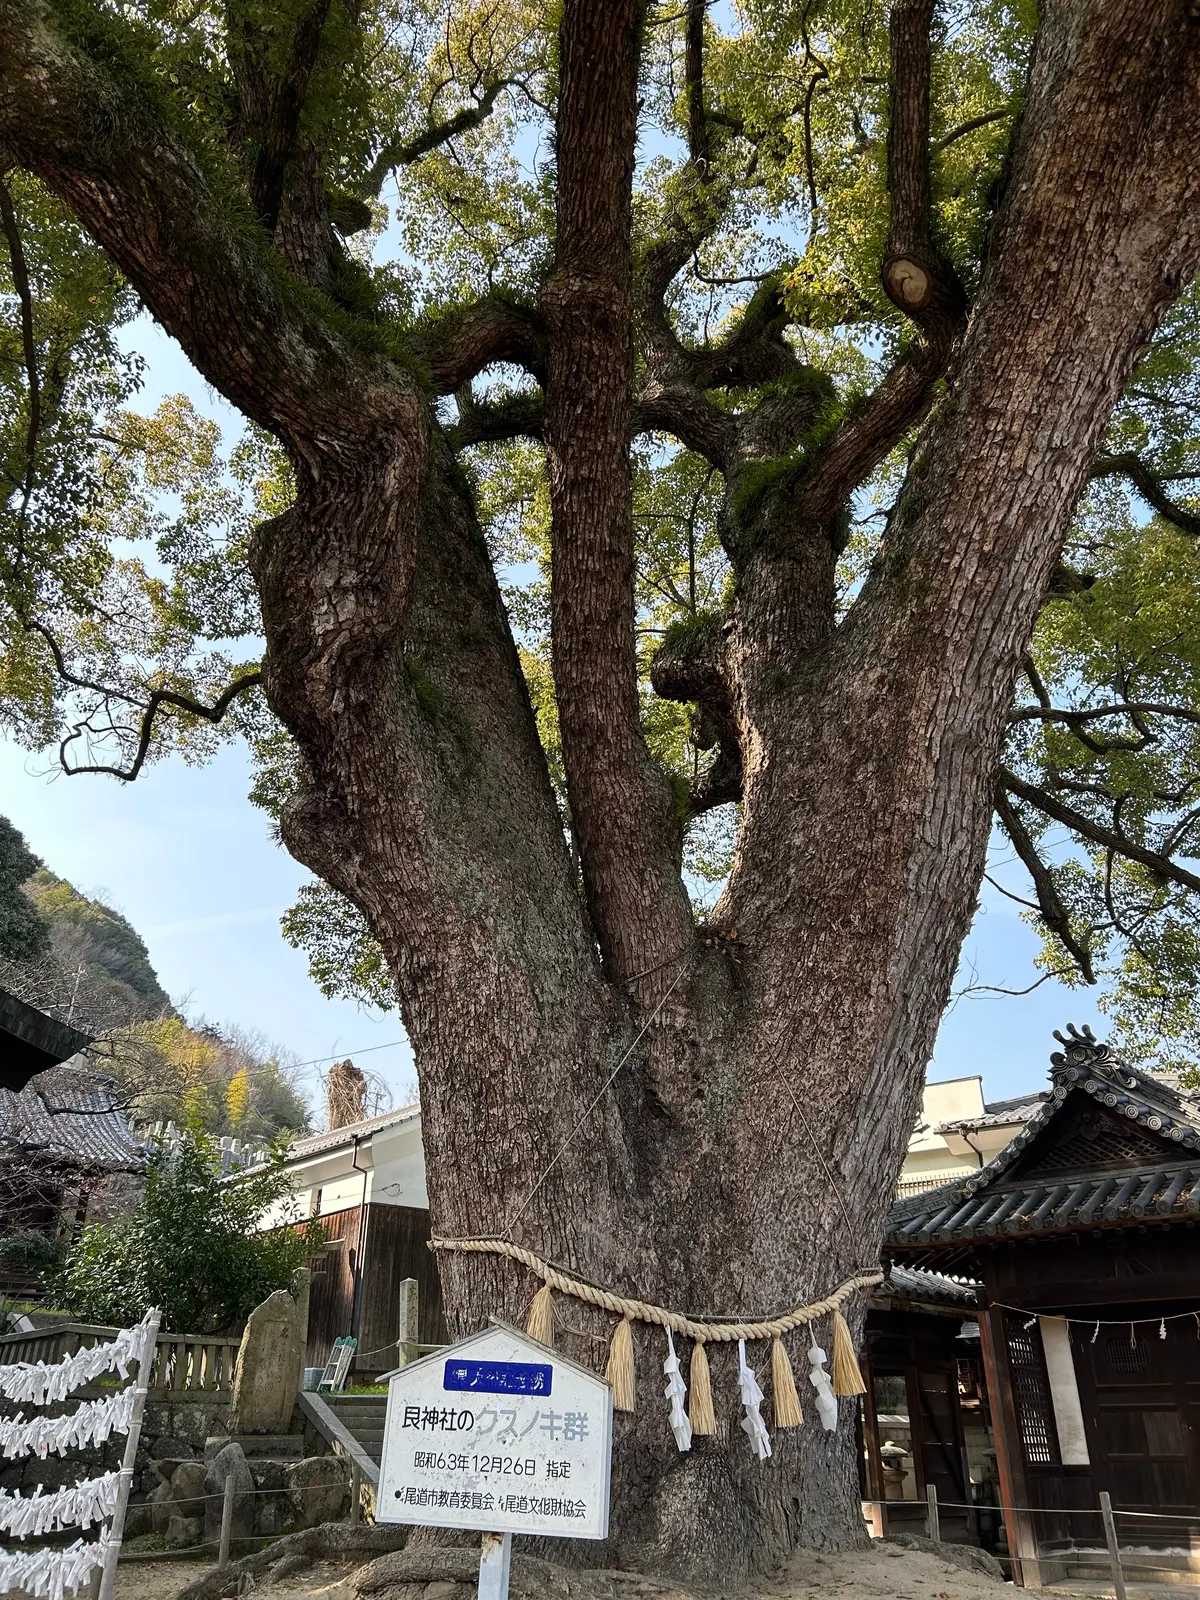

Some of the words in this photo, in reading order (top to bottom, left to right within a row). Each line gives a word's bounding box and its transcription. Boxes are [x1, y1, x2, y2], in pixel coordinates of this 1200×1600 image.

[402, 1405, 590, 1442] 艮神社のクスノキ群
[413, 1451, 536, 1476] 昭和63年12月26日
[546, 1460, 572, 1479] 指定
[404, 1487, 495, 1512] 尾道市教育委員会
[504, 1494, 587, 1520] 尾道文化財協会
